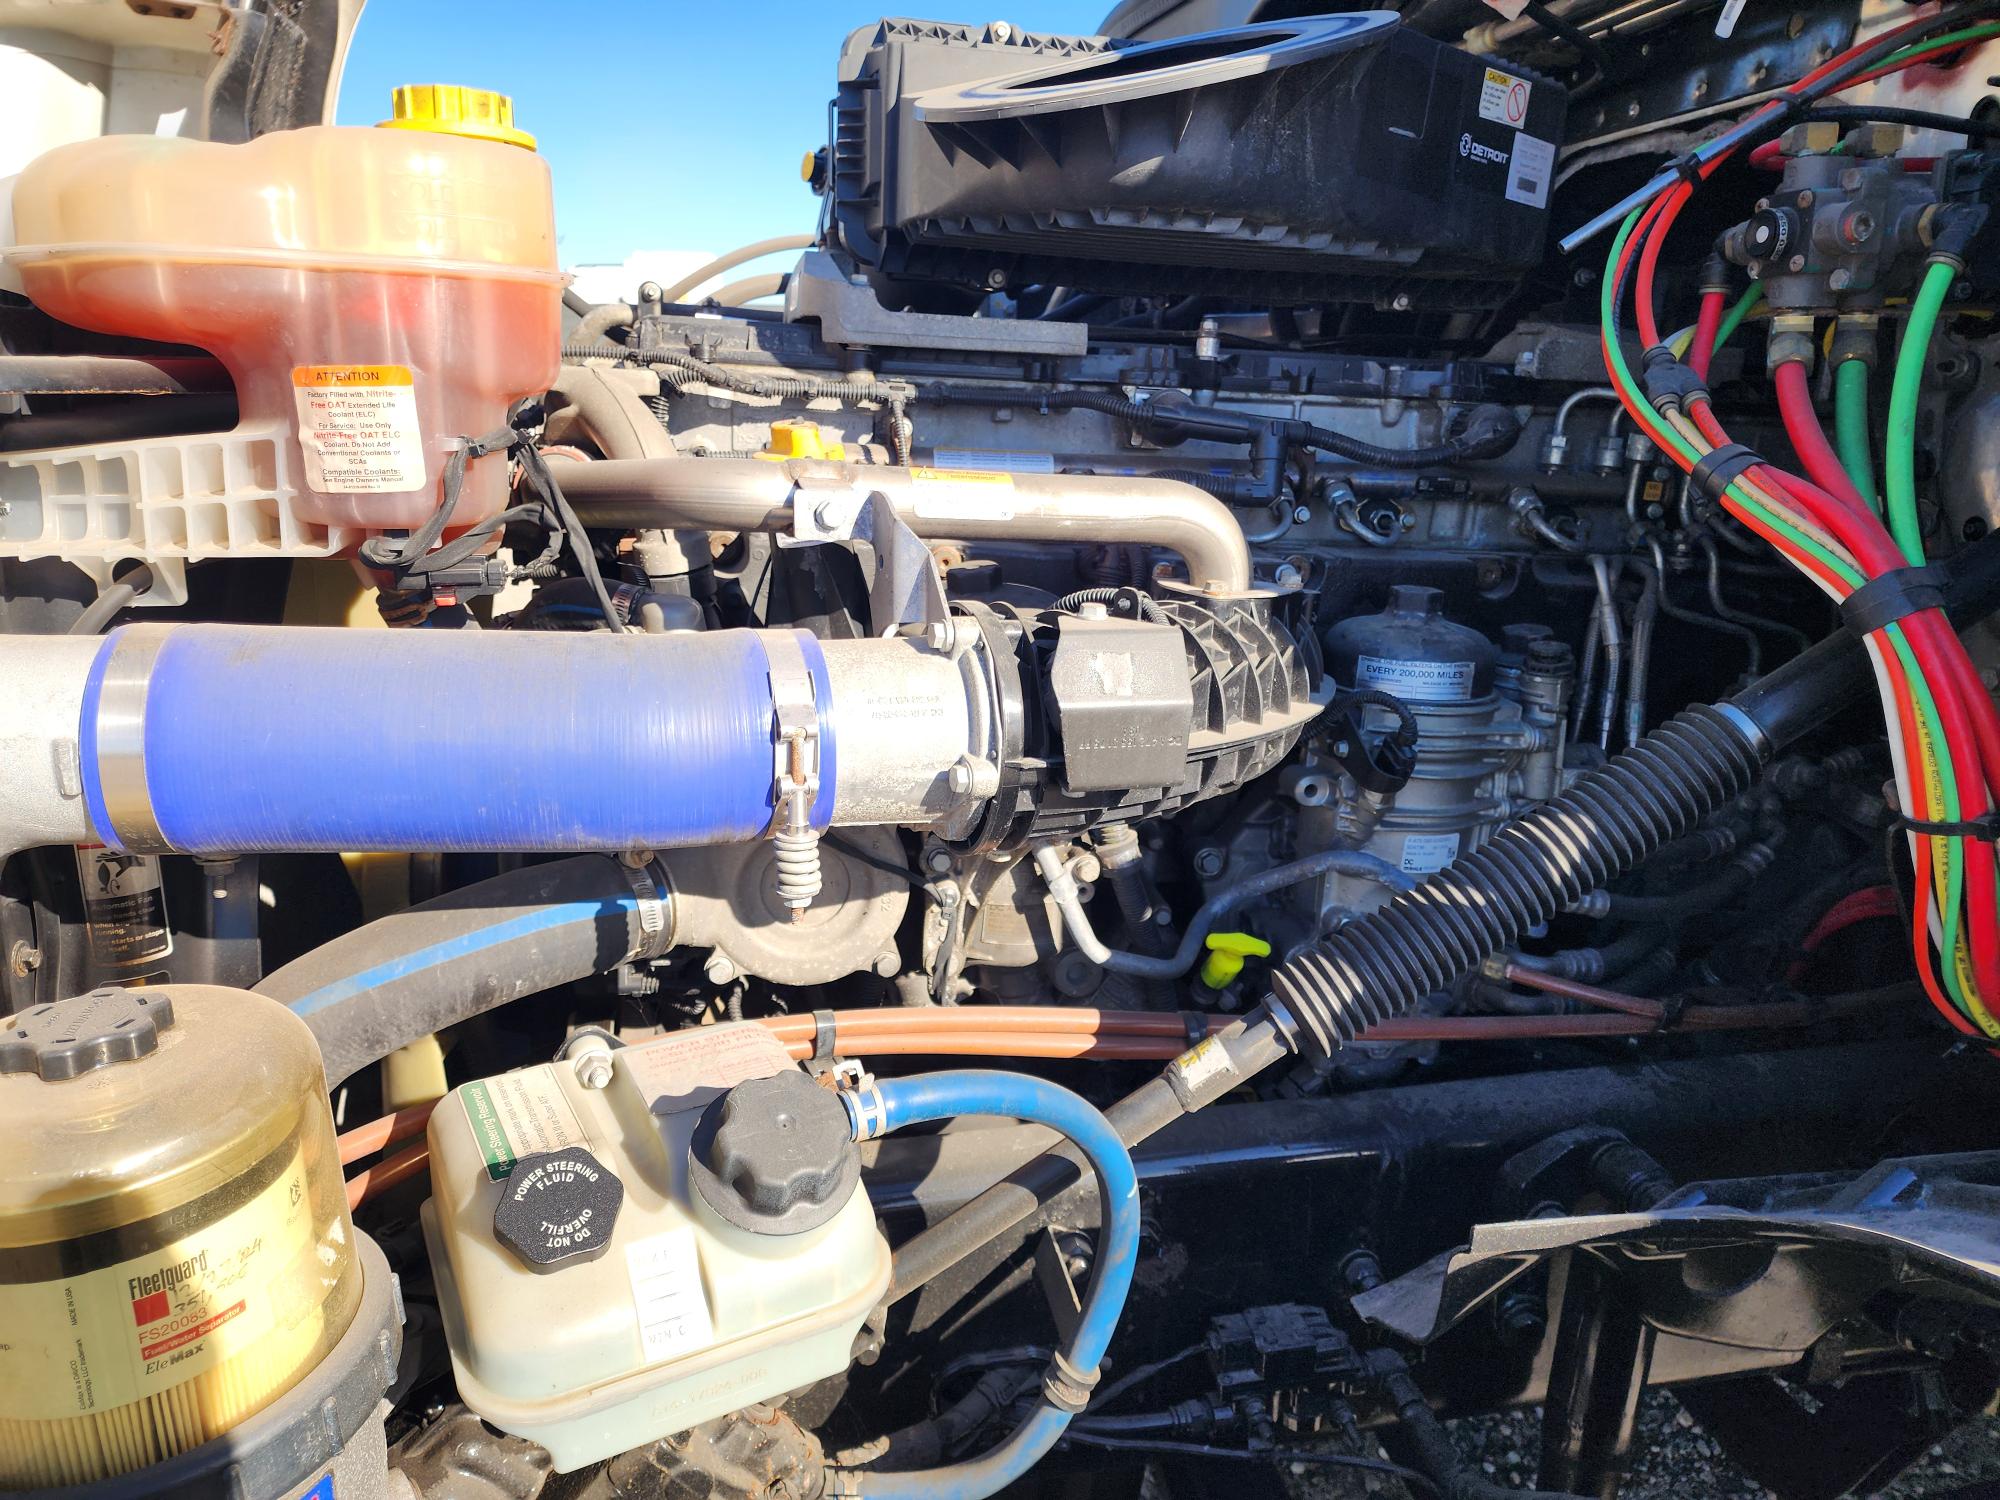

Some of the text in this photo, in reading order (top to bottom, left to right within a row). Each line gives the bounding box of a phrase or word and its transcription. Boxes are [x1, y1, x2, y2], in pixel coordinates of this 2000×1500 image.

[1471, 143, 1510, 165] DETROIT
[316, 371, 380, 383] ATTENTION
[307, 391, 328, 399] Factory
[366, 390, 397, 398] Nitrite-
[311, 401, 326, 409] Free
[327, 401, 346, 409] OAT
[382, 401, 396, 409] Life
[313, 430, 401, 440] Nitrite-Free OAT ELC
[329, 422, 356, 430] Service:
[375, 422, 392, 430] Only
[322, 468, 362, 476] Compatible
[1366, 664, 1397, 676] EVERY
[1399, 670, 1435, 680] 200,000
[1437, 671, 1465, 680] MILES
[518, 1090, 538, 1123] Transmission
[471, 1087, 512, 1171] Power Steering Reservoir
[535, 1122, 551, 1151] Automatic
[514, 1161, 599, 1201] POWER STEERING
[536, 1172, 575, 1191] FLUID
[540, 1208, 593, 1236] OVERFILL
[546, 1228, 591, 1248] DO NOT
[128, 1250, 208, 1301] Fleetguard
[68, 1308, 77, 1326] MADE
[144, 1306, 241, 1358] Fuel/Water Separator
